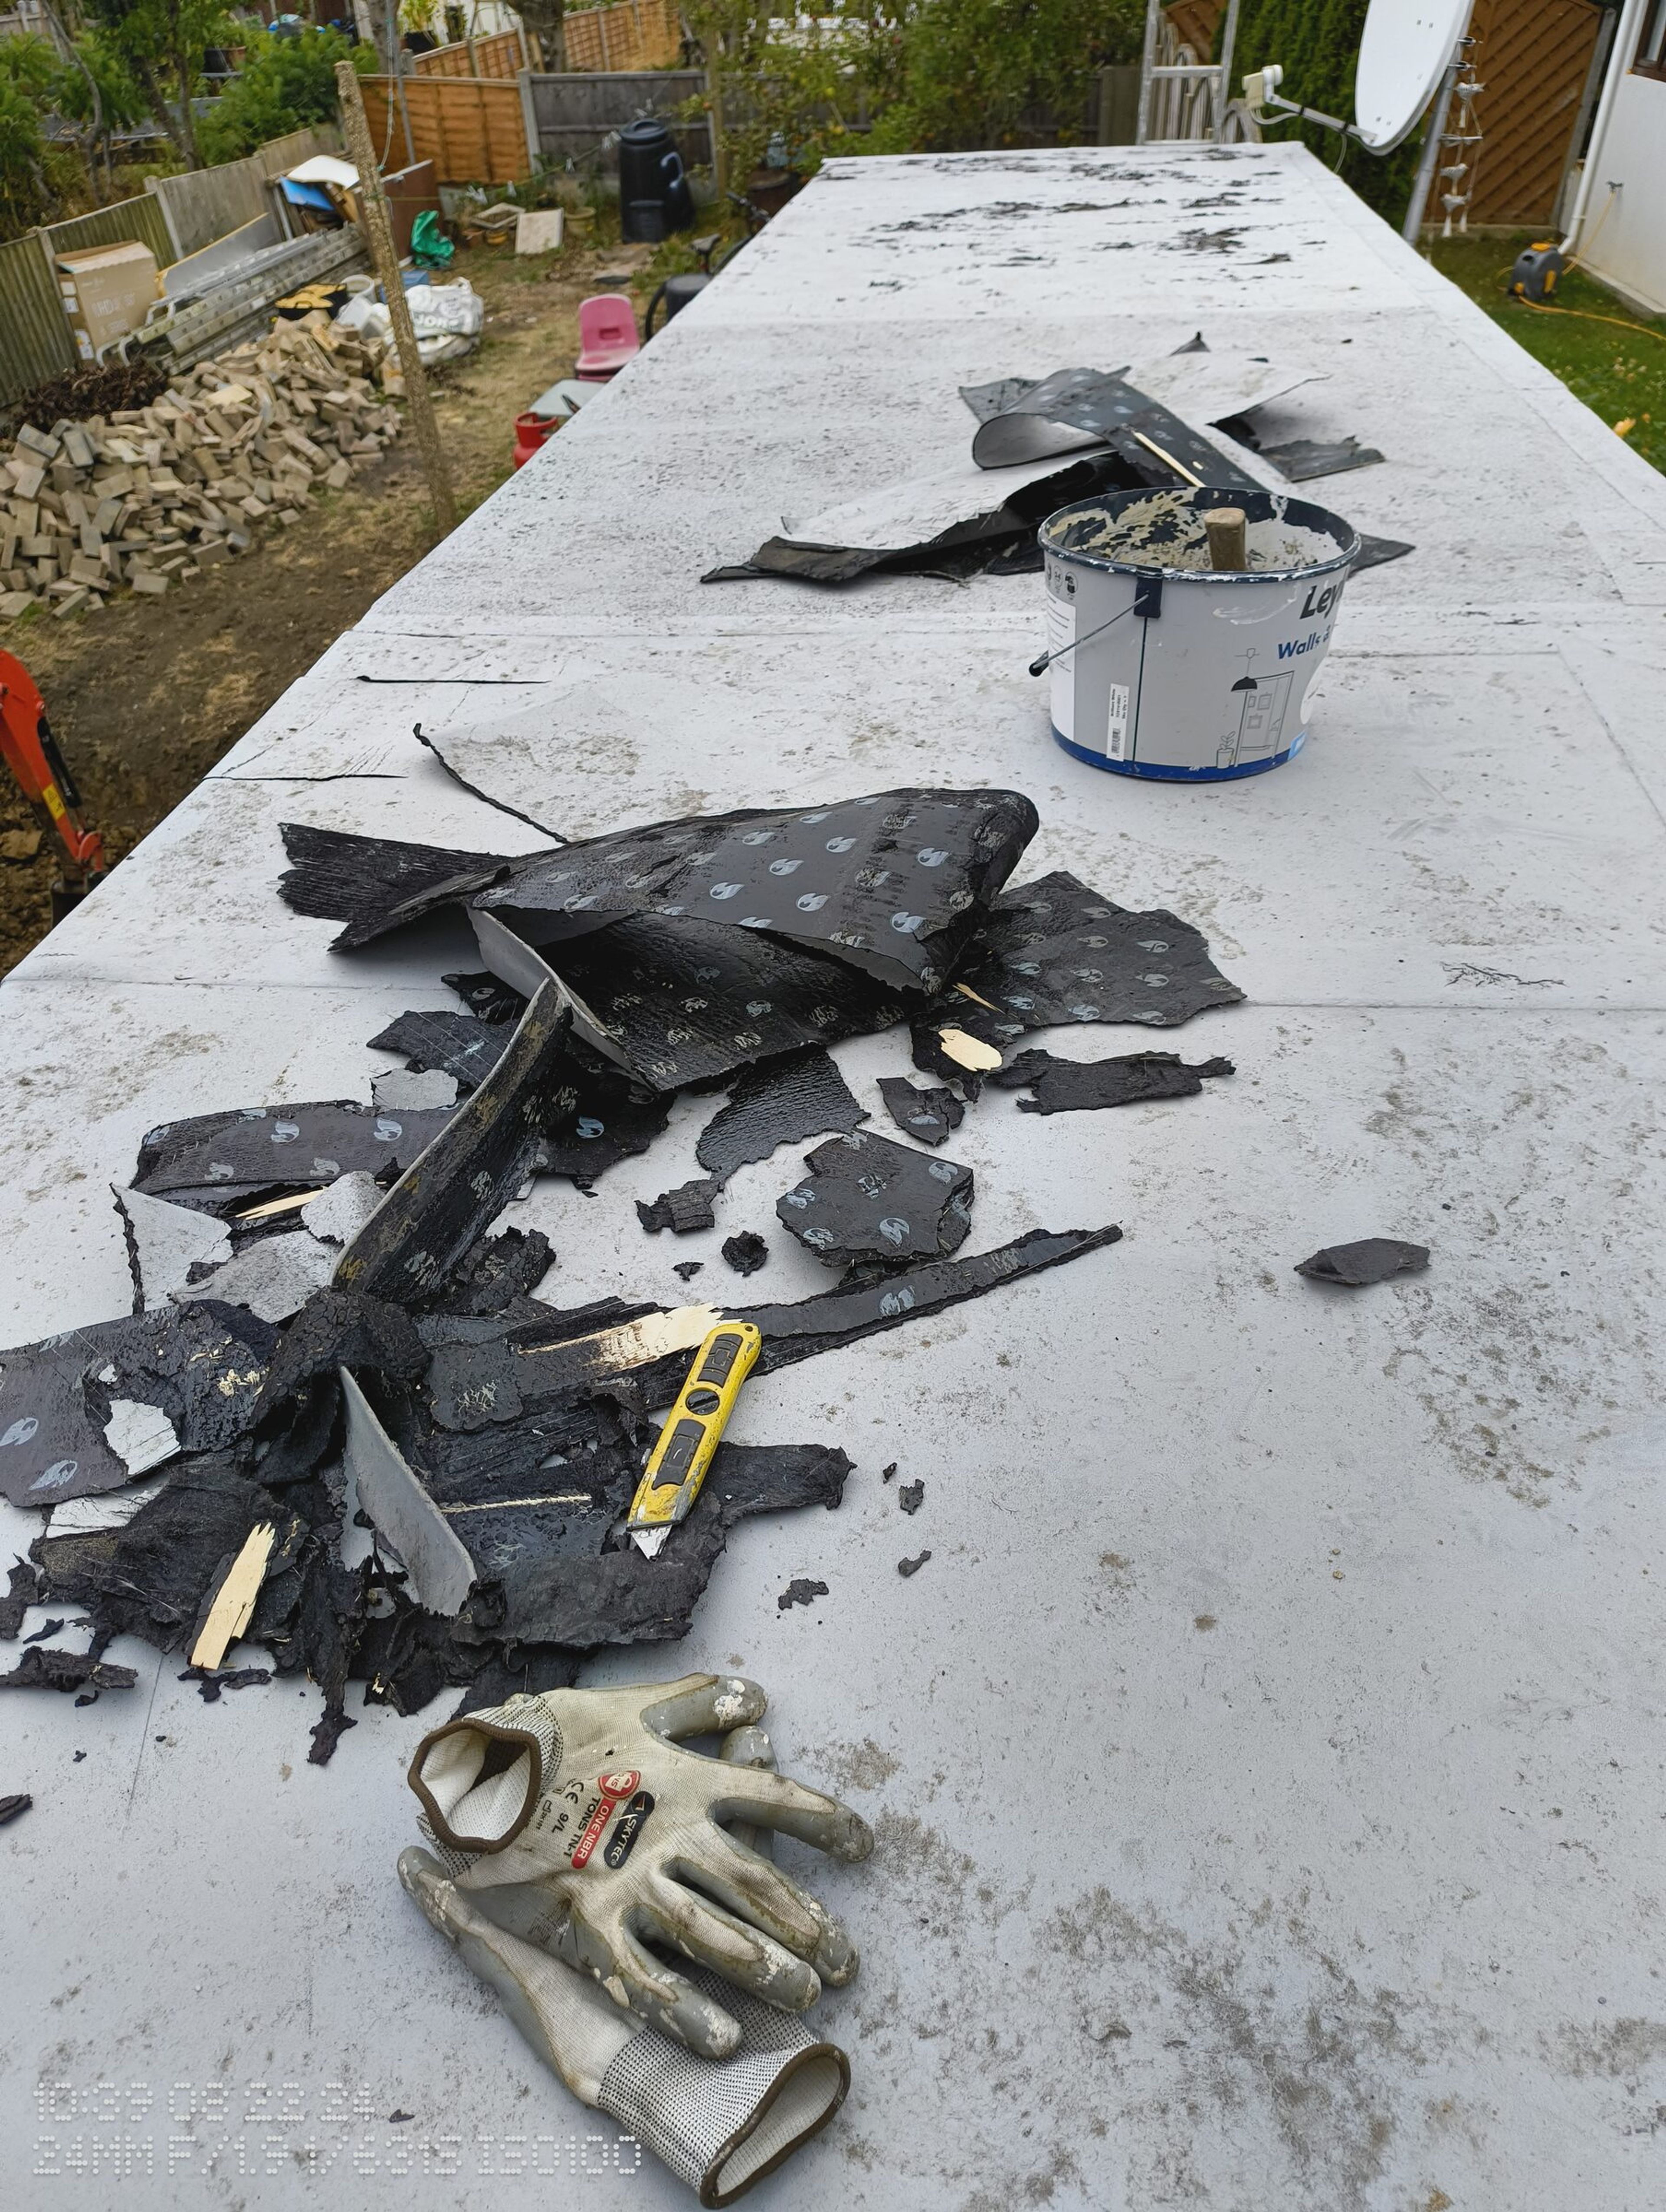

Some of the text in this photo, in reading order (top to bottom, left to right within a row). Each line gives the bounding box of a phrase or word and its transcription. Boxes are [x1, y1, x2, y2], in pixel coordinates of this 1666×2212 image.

[1278, 632, 1321, 659] Walls
[565, 1782, 584, 1804] CE
[551, 1812, 569, 1833] 9/L
[578, 1797, 600, 1831] TONS
[577, 1805, 609, 1859] ONE NBR
